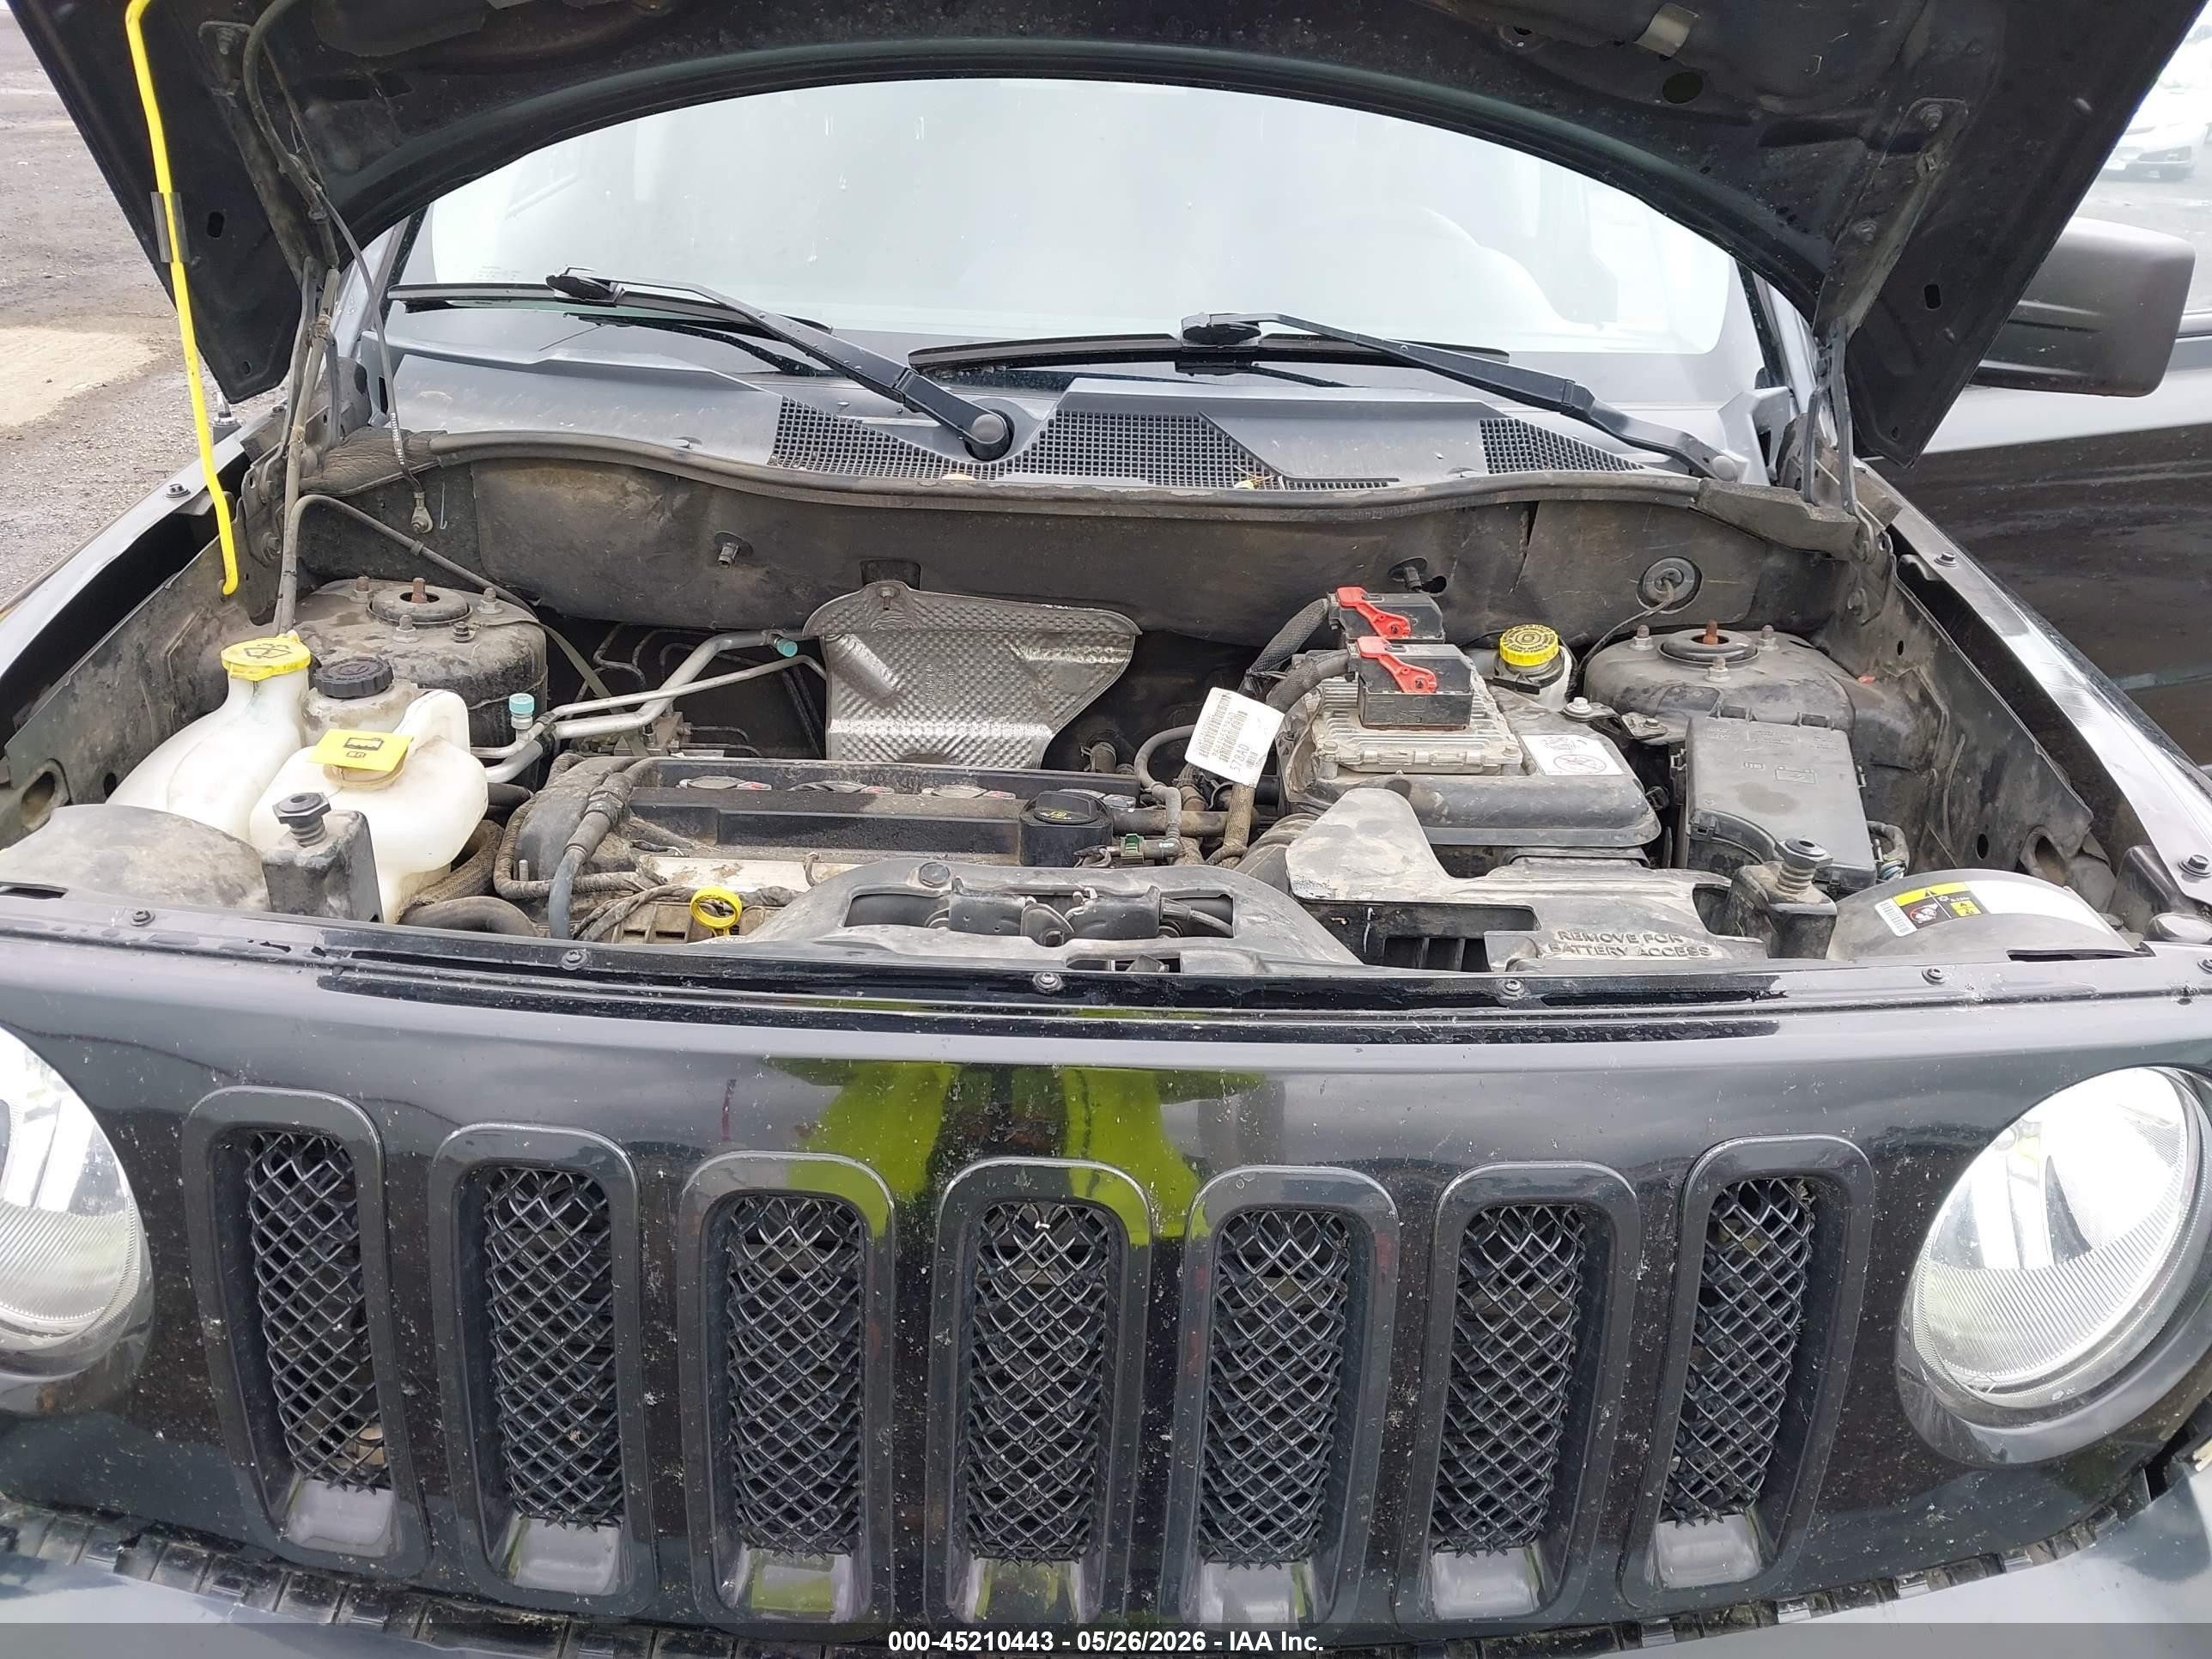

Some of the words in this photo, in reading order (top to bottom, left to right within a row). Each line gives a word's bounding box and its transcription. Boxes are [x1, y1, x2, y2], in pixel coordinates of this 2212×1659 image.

[1557, 931, 1639, 944] REMOVE
[1643, 933, 1685, 944] FOR
[1548, 944, 1629, 956] BATTERY
[1637, 946, 1712, 957] ACCESS
